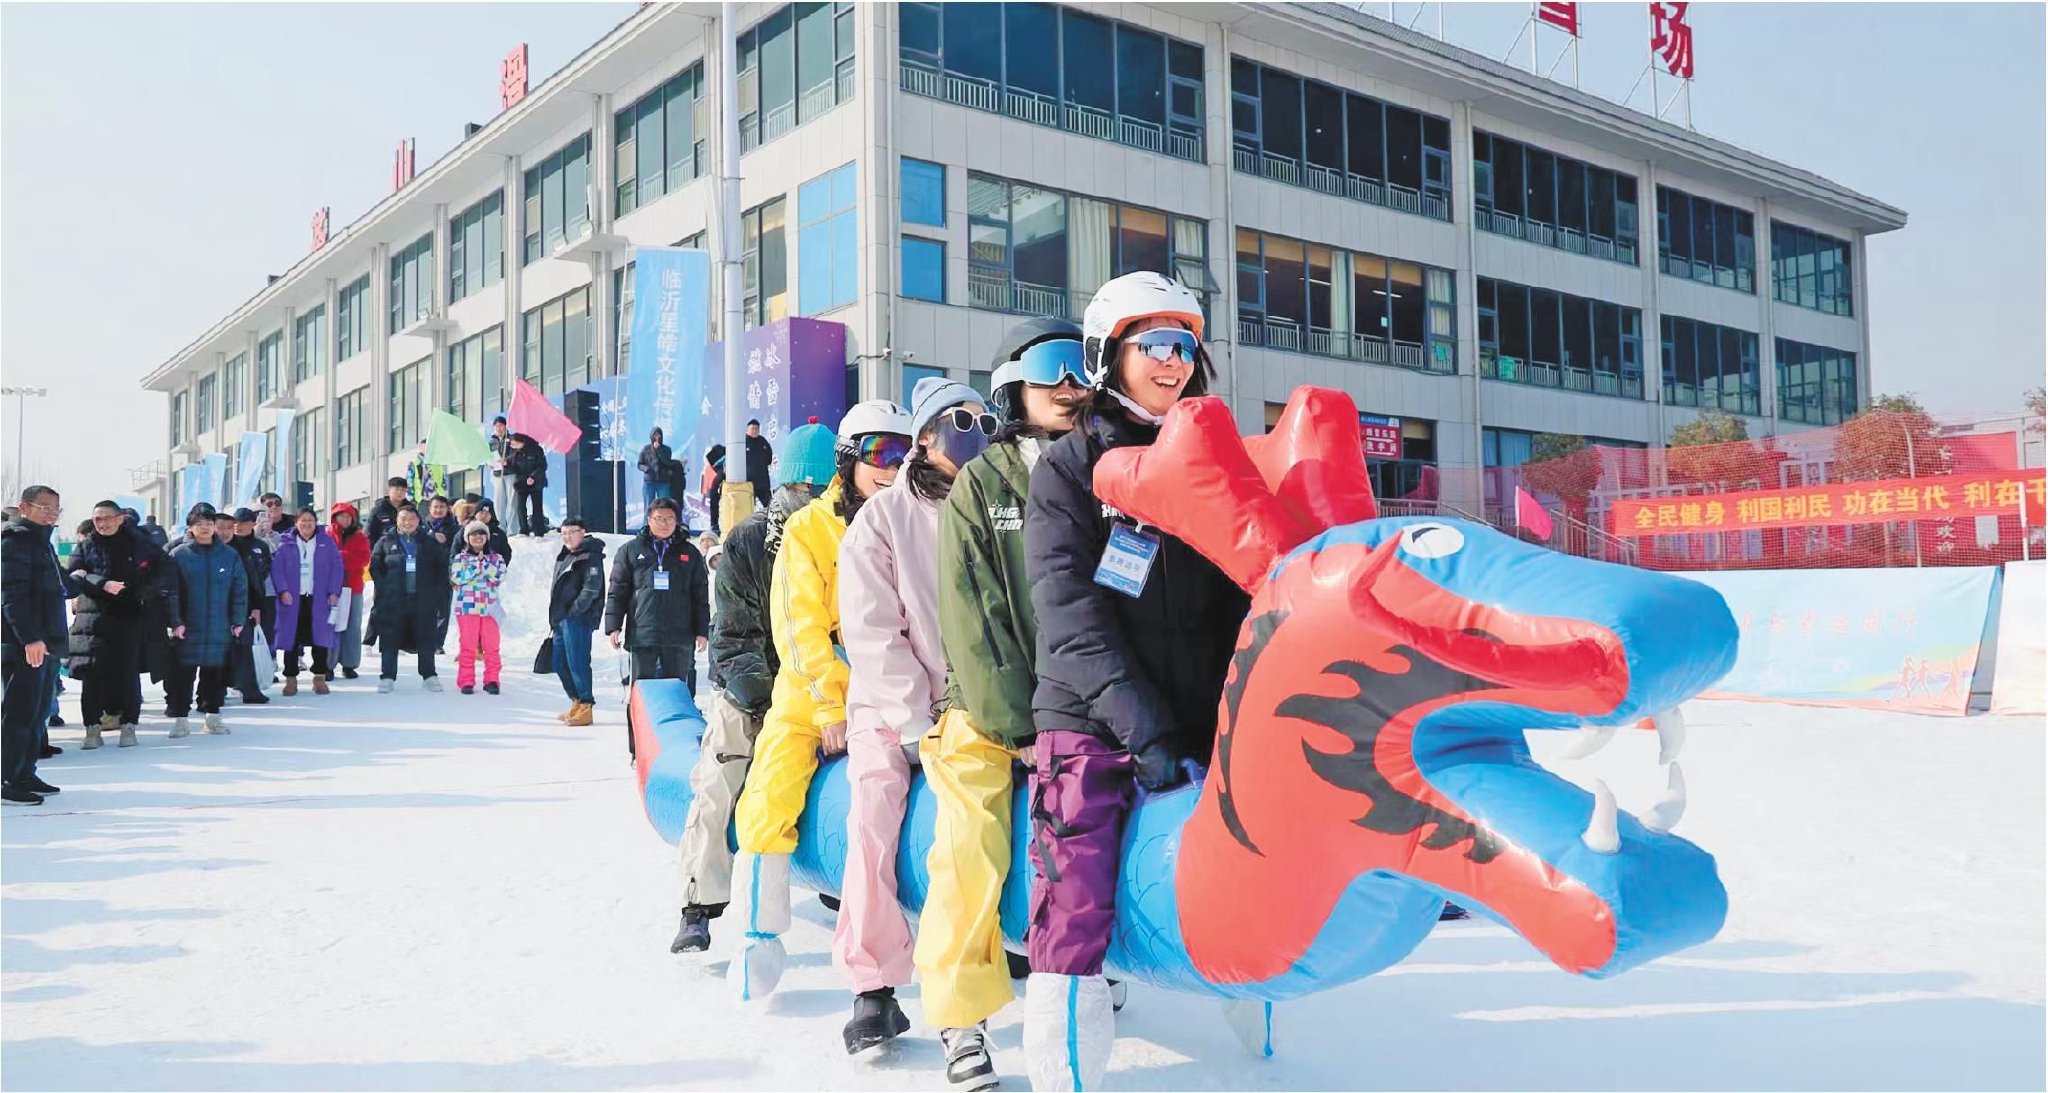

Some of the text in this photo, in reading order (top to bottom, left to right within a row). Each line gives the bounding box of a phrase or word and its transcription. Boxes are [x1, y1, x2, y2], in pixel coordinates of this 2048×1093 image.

[1635, 499, 1726, 529] 全民健身
[1738, 493, 1832, 523] 利国利民
[1843, 484, 1950, 516] 功在当代
